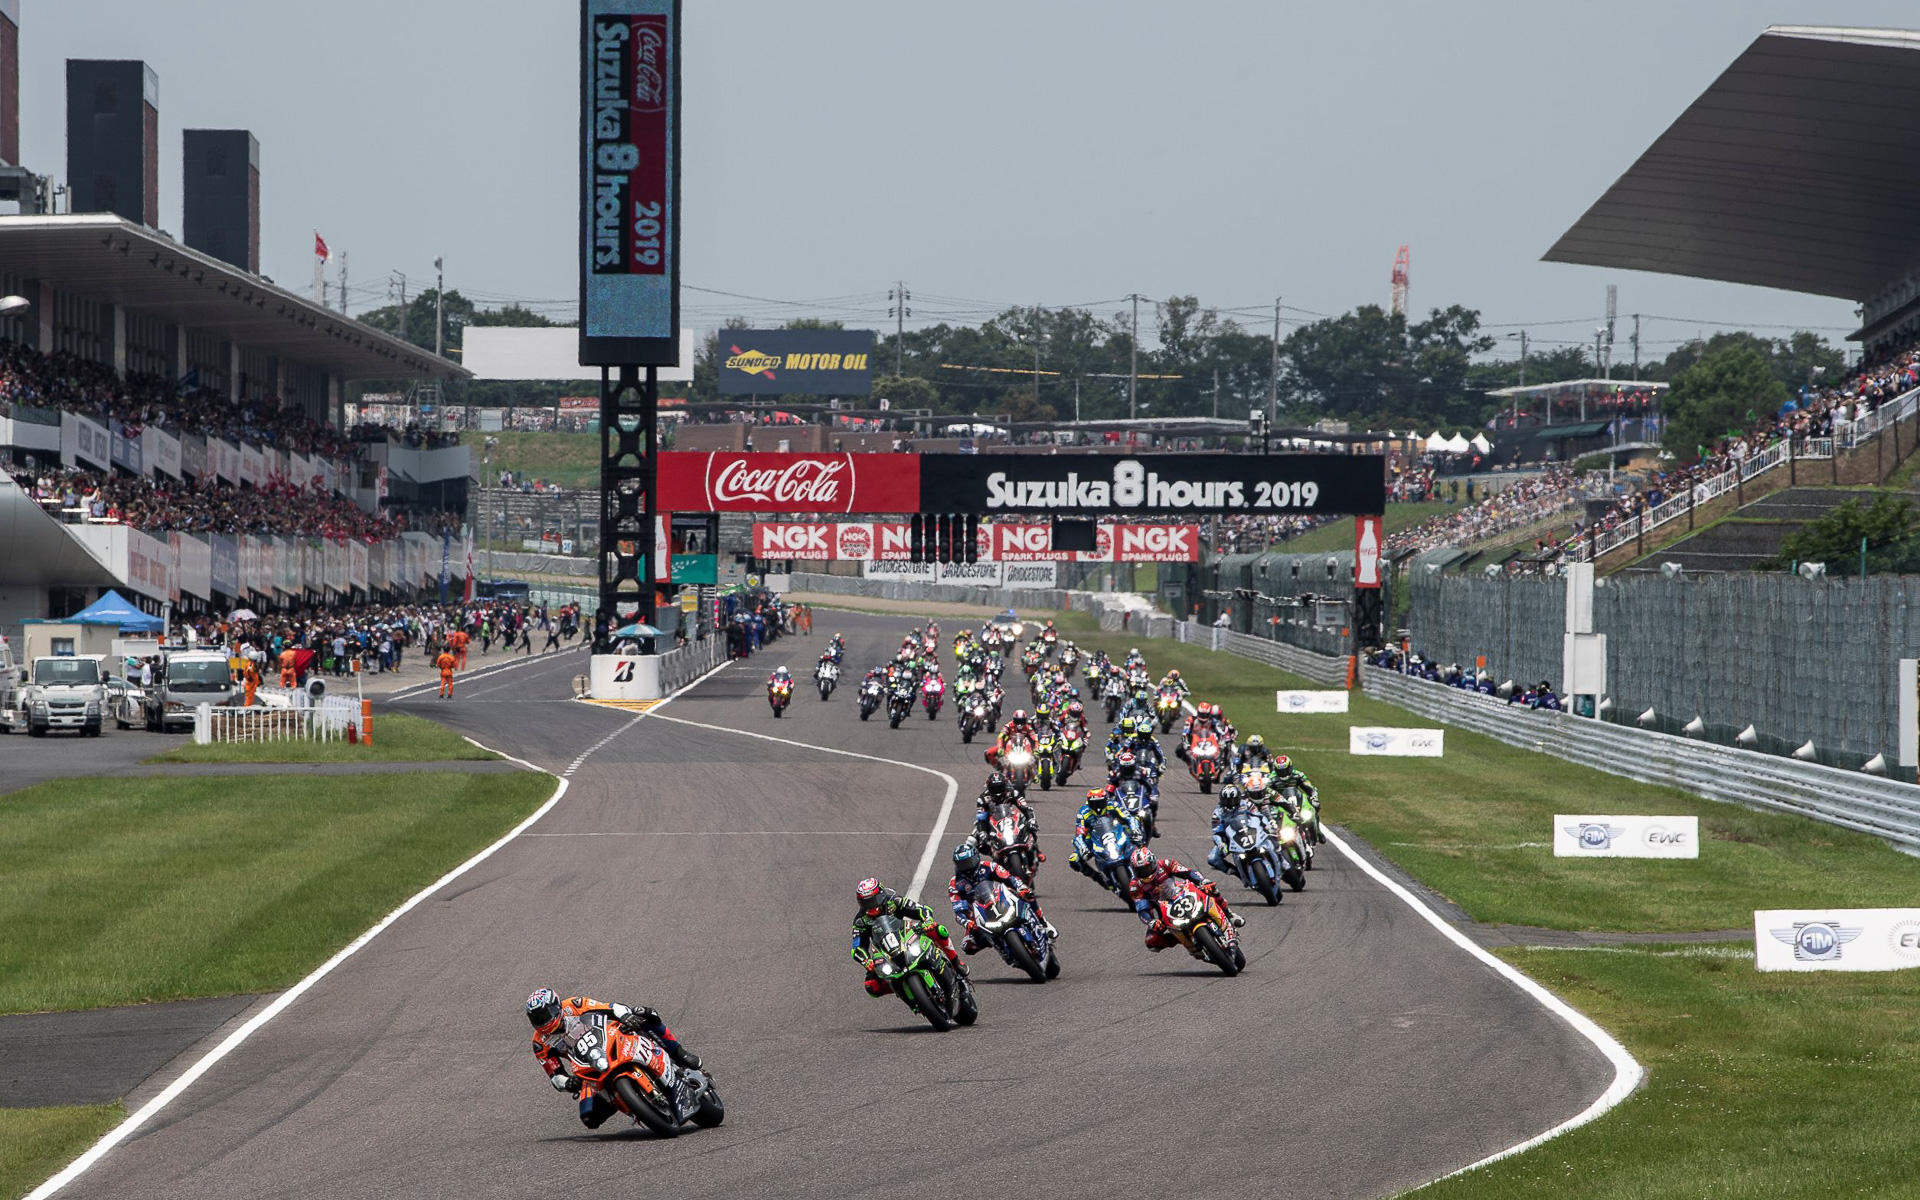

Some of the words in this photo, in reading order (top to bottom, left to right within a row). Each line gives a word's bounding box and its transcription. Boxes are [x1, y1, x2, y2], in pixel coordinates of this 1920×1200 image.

[596, 22, 629, 140] Suzuka
[597, 143, 640, 171] 8
[635, 201, 661, 266] 2019
[727, 356, 779, 368] SUNOCO
[785, 353, 839, 370] MOTOR
[842, 353, 867, 370] OIL
[715, 459, 846, 503] Coca-Cola
[986, 472, 1110, 507] Suzuka
[1113, 460, 1145, 507] 8
[1253, 481, 1319, 507] 2019
[763, 525, 828, 550] NGK
[1002, 526, 1052, 552] NG
[1121, 527, 1190, 553] NGK
[761, 551, 793, 560] SPARK
[795, 551, 829, 560] PLUGS
[1001, 552, 1033, 561] SPARK
[1035, 552, 1069, 561] PLUGS
[1121, 552, 1154, 562] SPARK
[1156, 552, 1190, 562] PLUGS
[1007, 565, 1053, 583] BRIDGESTONE
[1127, 798, 1138, 809] 7
[1240, 834, 1256, 848] 21
[1585, 831, 1605, 842] FIM
[1649, 833, 1687, 844] EWC
[1173, 898, 1194, 918] 33
[881, 932, 900, 953] 10
[1802, 931, 1832, 949] FIM
[576, 1031, 599, 1056] 95
